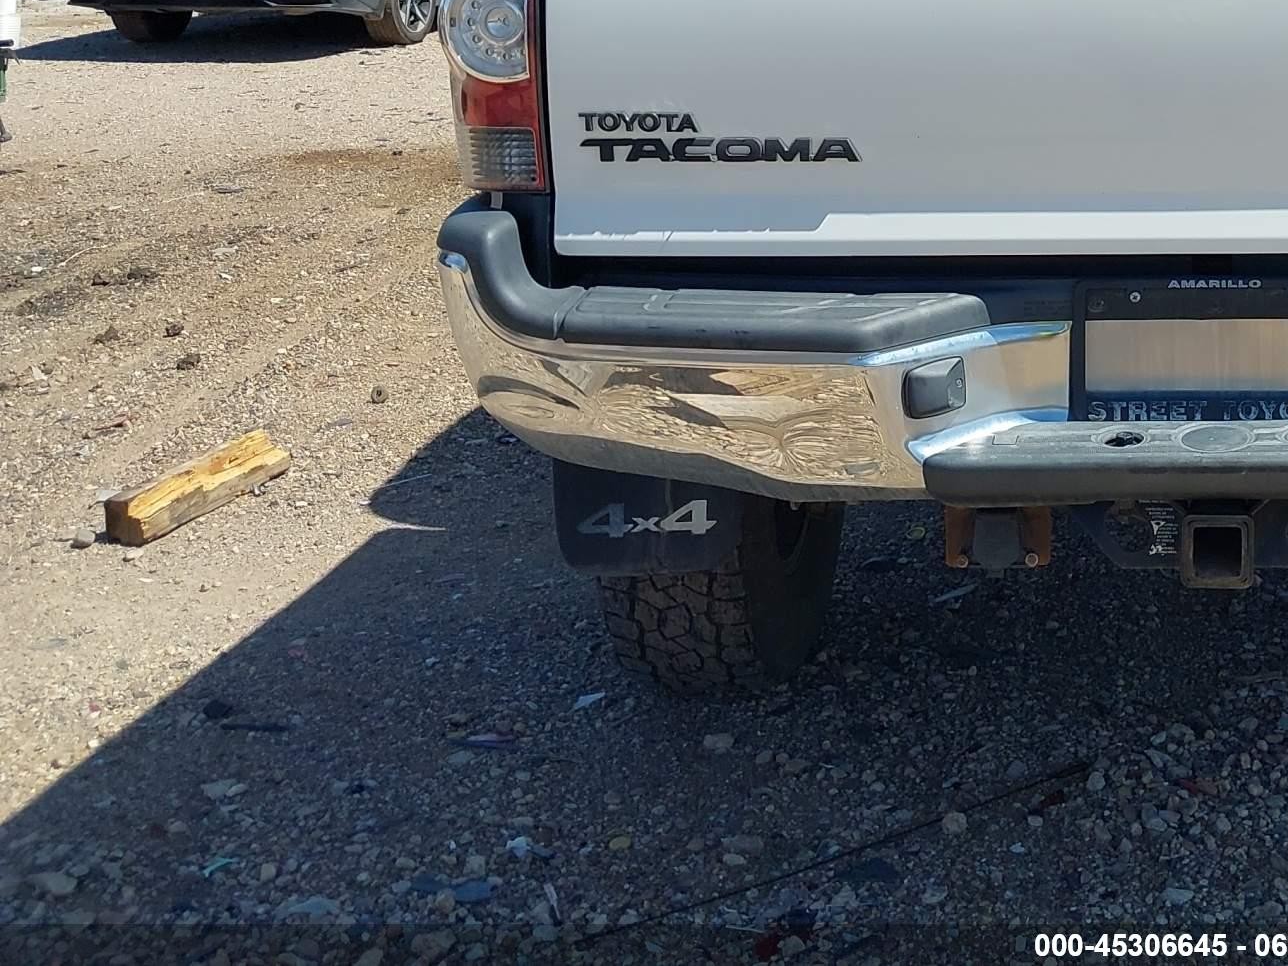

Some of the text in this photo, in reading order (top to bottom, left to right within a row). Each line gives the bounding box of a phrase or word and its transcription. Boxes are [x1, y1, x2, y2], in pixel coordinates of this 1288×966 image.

[578, 113, 699, 132] TOYOTA
[580, 138, 862, 162] TACOMA
[1167, 278, 1262, 290] AMARILLO
[1087, 400, 1208, 422] STREET
[576, 499, 717, 538] 4x4
